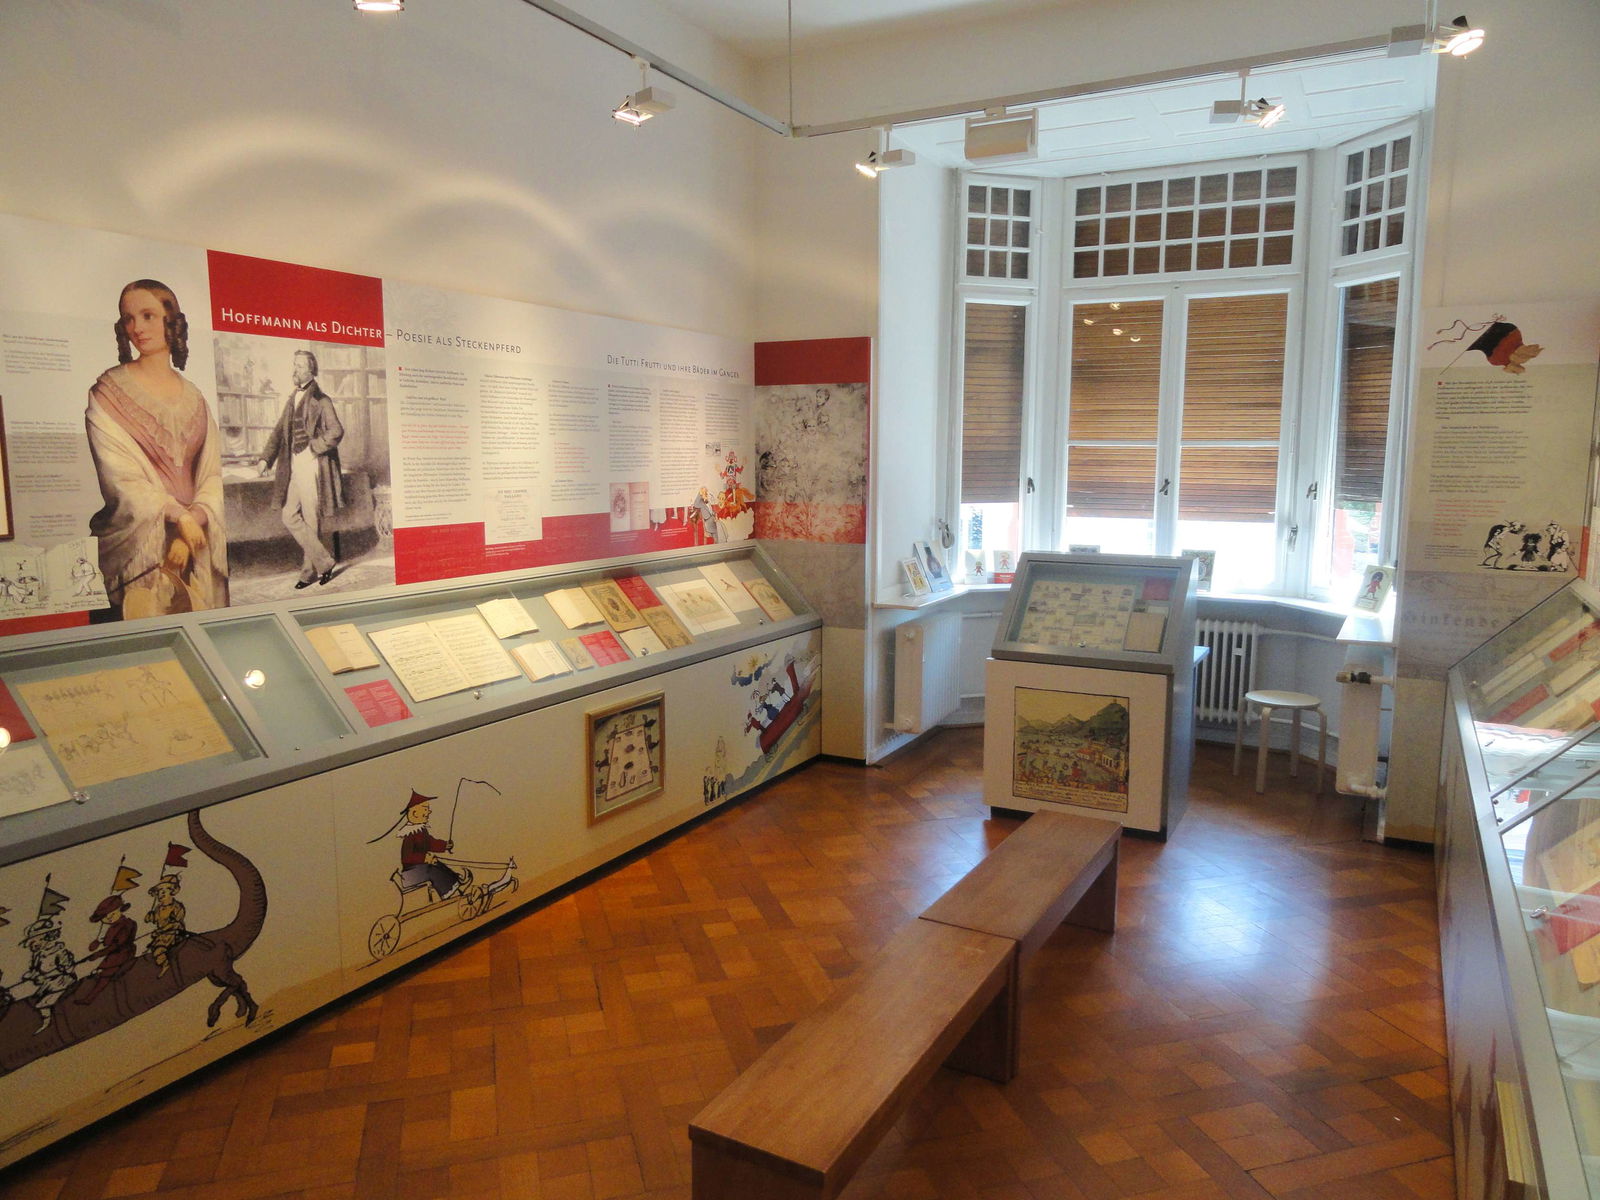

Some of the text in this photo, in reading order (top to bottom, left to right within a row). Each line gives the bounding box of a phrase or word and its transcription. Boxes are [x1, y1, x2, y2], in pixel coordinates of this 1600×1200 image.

[221, 307, 302, 330] HOFFMANN
[332, 321, 382, 339] DICHTER
[396, 329, 432, 344] POESIE
[455, 336, 521, 354] STECKENPFERD
